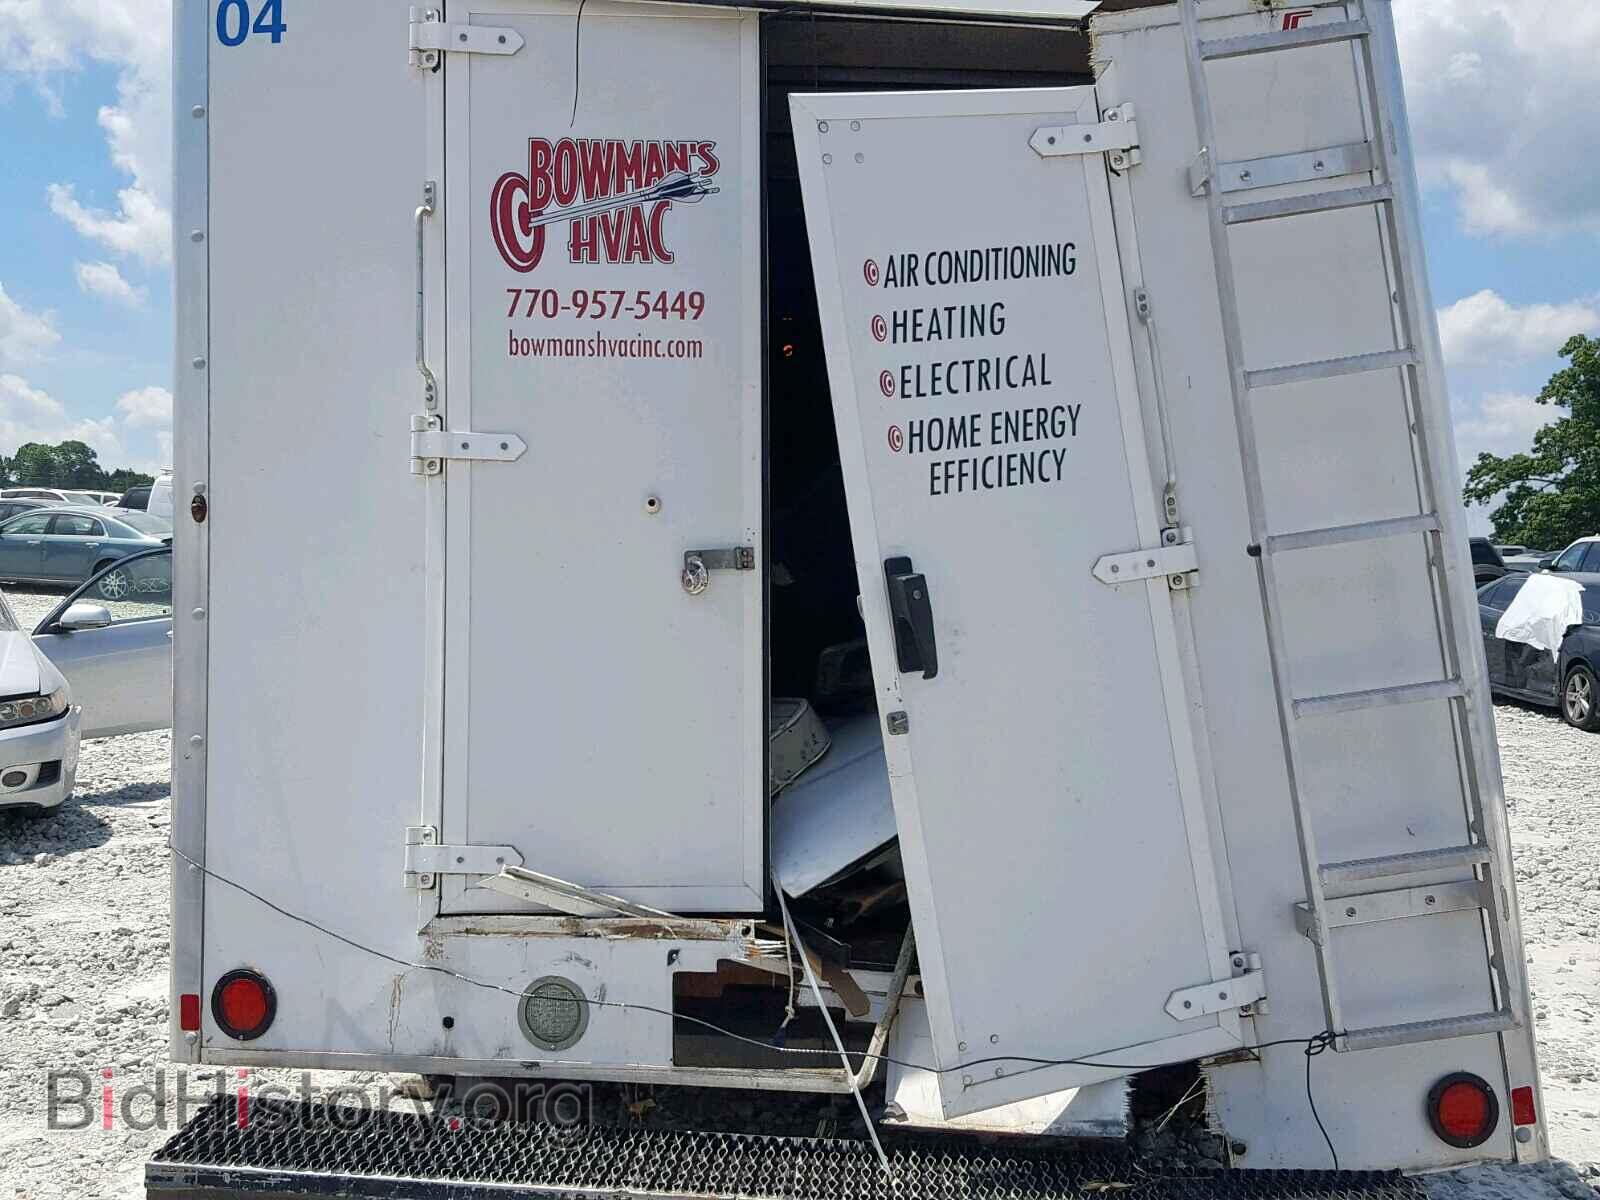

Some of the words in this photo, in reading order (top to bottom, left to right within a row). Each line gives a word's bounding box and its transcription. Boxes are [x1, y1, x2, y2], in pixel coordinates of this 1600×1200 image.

[217, 0, 287, 46] 04
[528, 137, 720, 212] BOWMAN'S
[568, 200, 674, 264] HVAC
[884, 253, 919, 289] AIR
[925, 242, 1076, 286] CONDITIONING
[506, 288, 705, 320] 770-957-5449
[892, 302, 1006, 344] HEATING
[509, 329, 703, 358] bowmanshvacinc.com
[900, 353, 1052, 399] ELECTRICAL
[908, 413, 981, 454] HOME
[991, 404, 1081, 445] ENERGY
[930, 448, 1066, 496] EFFICIENCY
